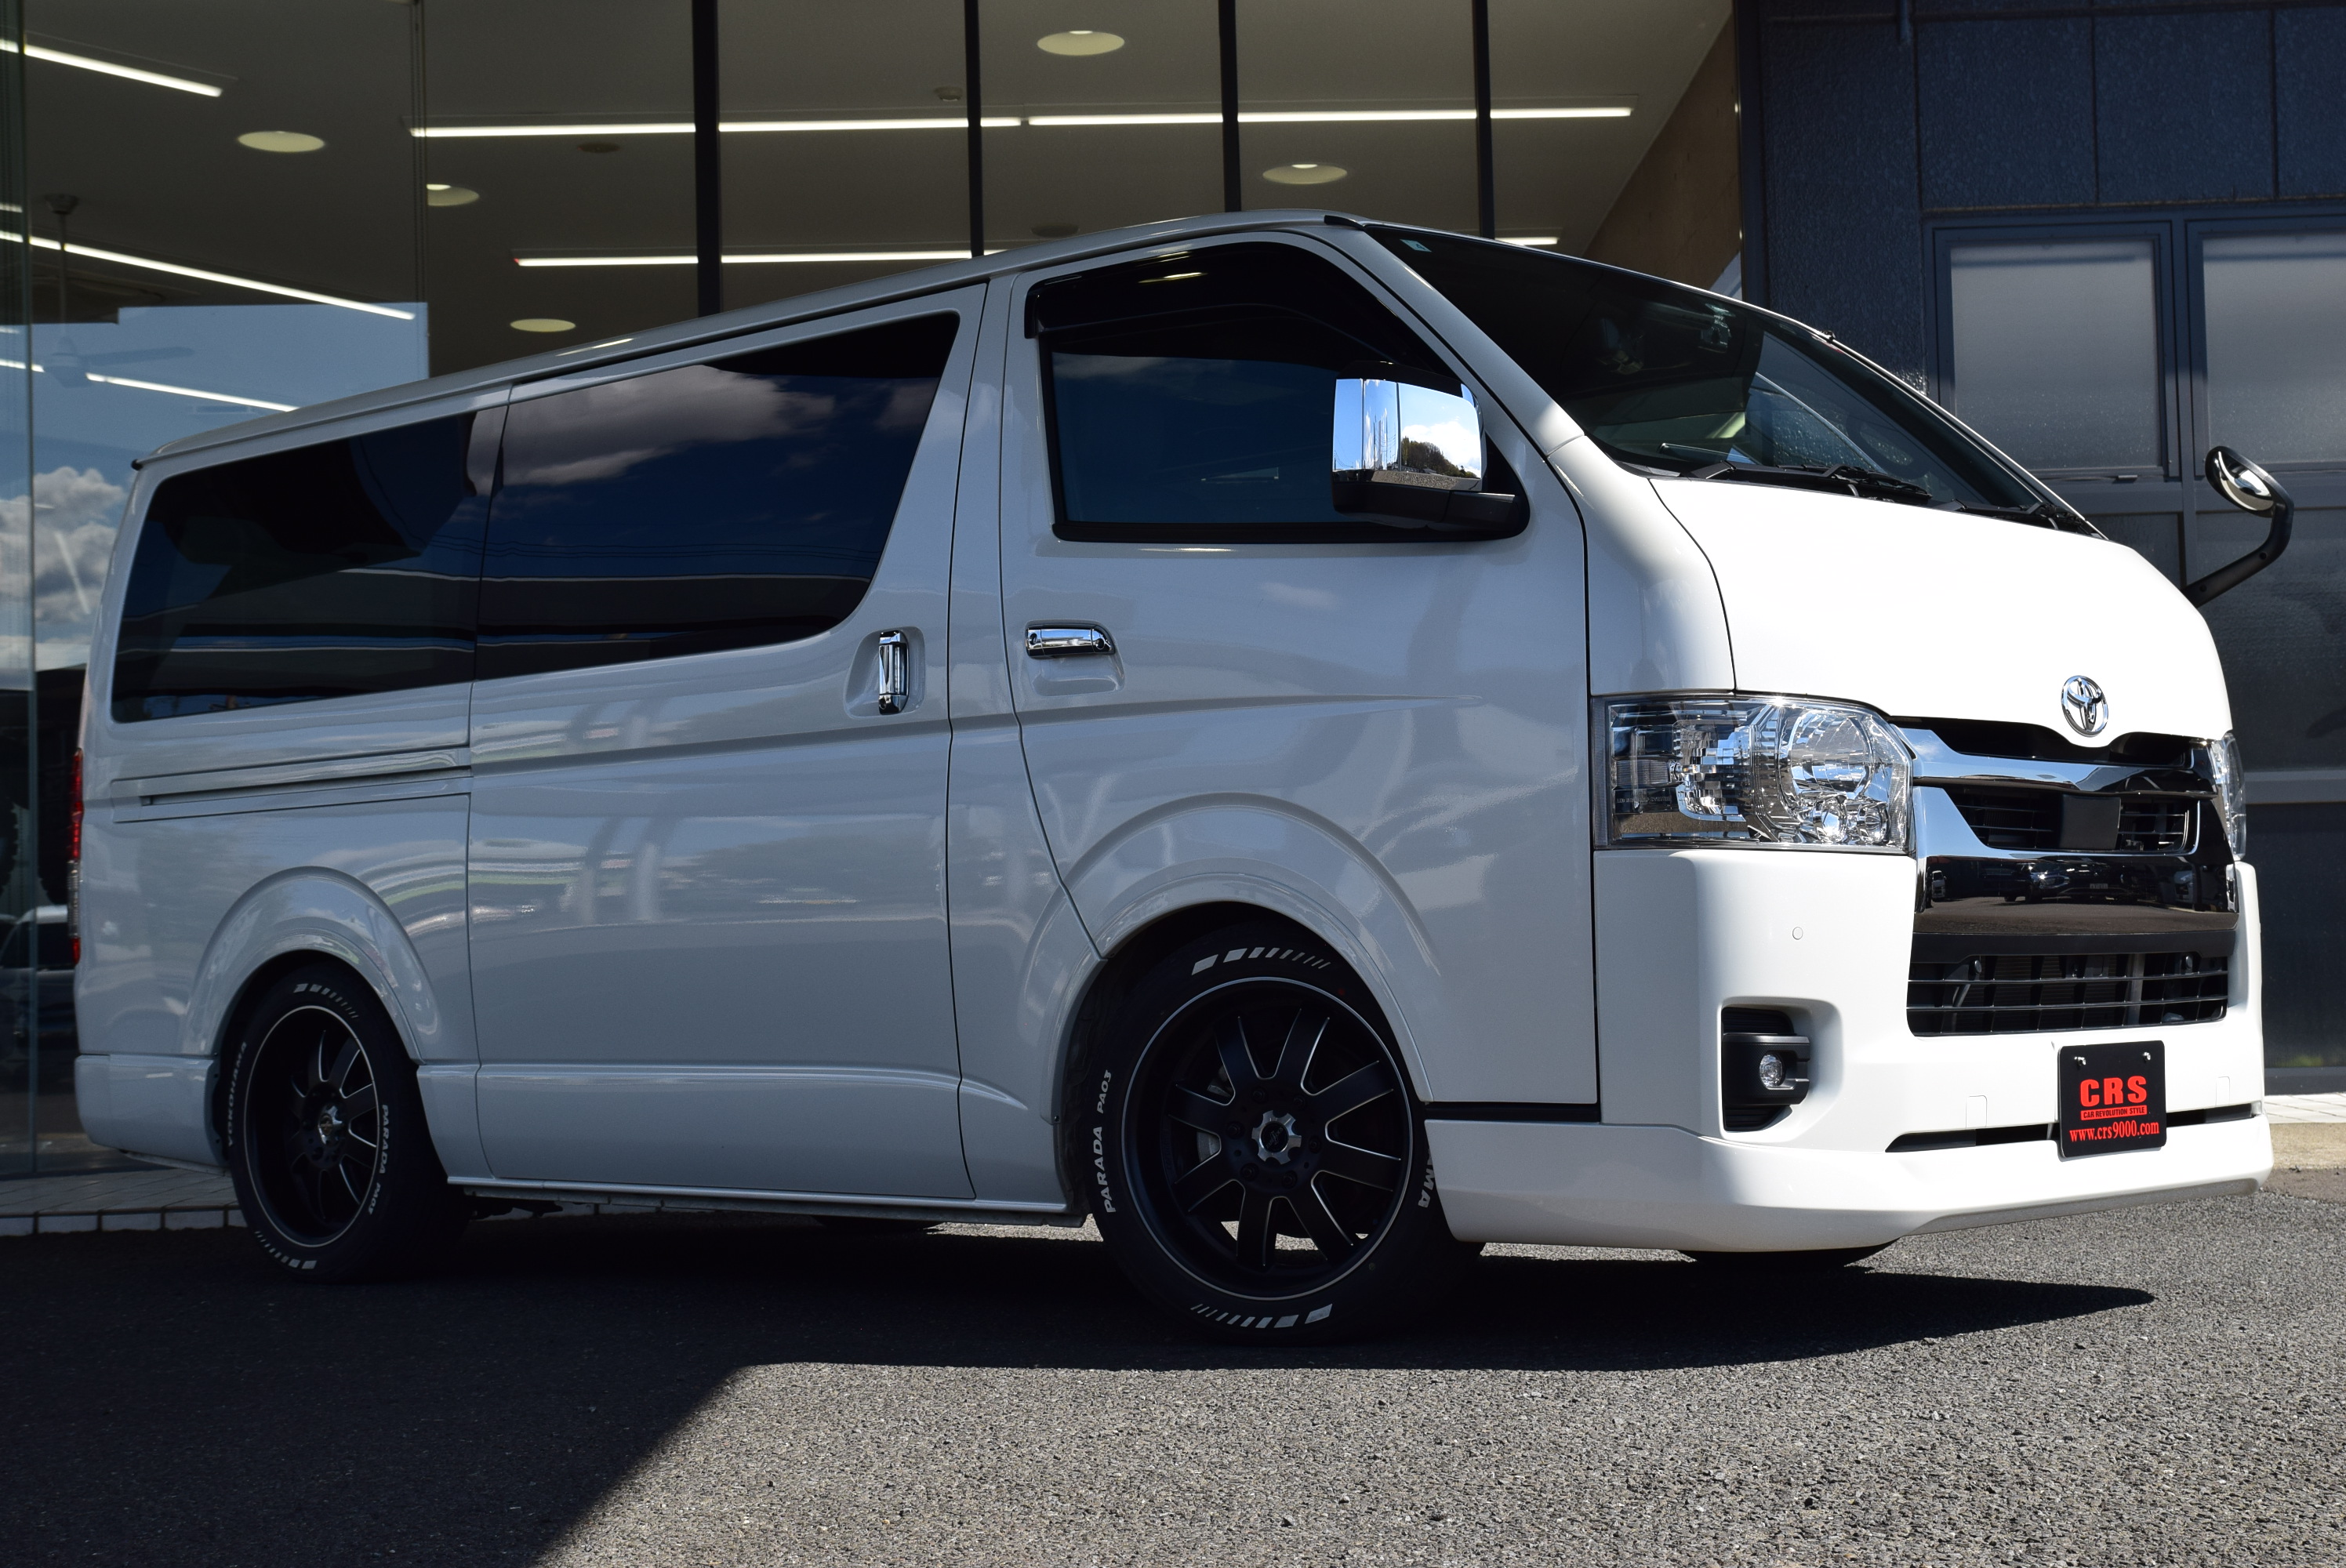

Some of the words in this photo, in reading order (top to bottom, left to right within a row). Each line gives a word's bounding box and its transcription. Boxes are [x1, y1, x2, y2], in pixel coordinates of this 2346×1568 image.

[1098, 1069, 1112, 1114] PA03
[2080, 1076, 2148, 1107] CRS
[2069, 1120, 2160, 1142] www.crs9000.com
[2083, 1110, 2094, 1119] CAR
[2096, 1109, 2128, 1118] REVOLUTION
[379, 1104, 390, 1174] PARADA
[1093, 1127, 1116, 1213] PARADA
